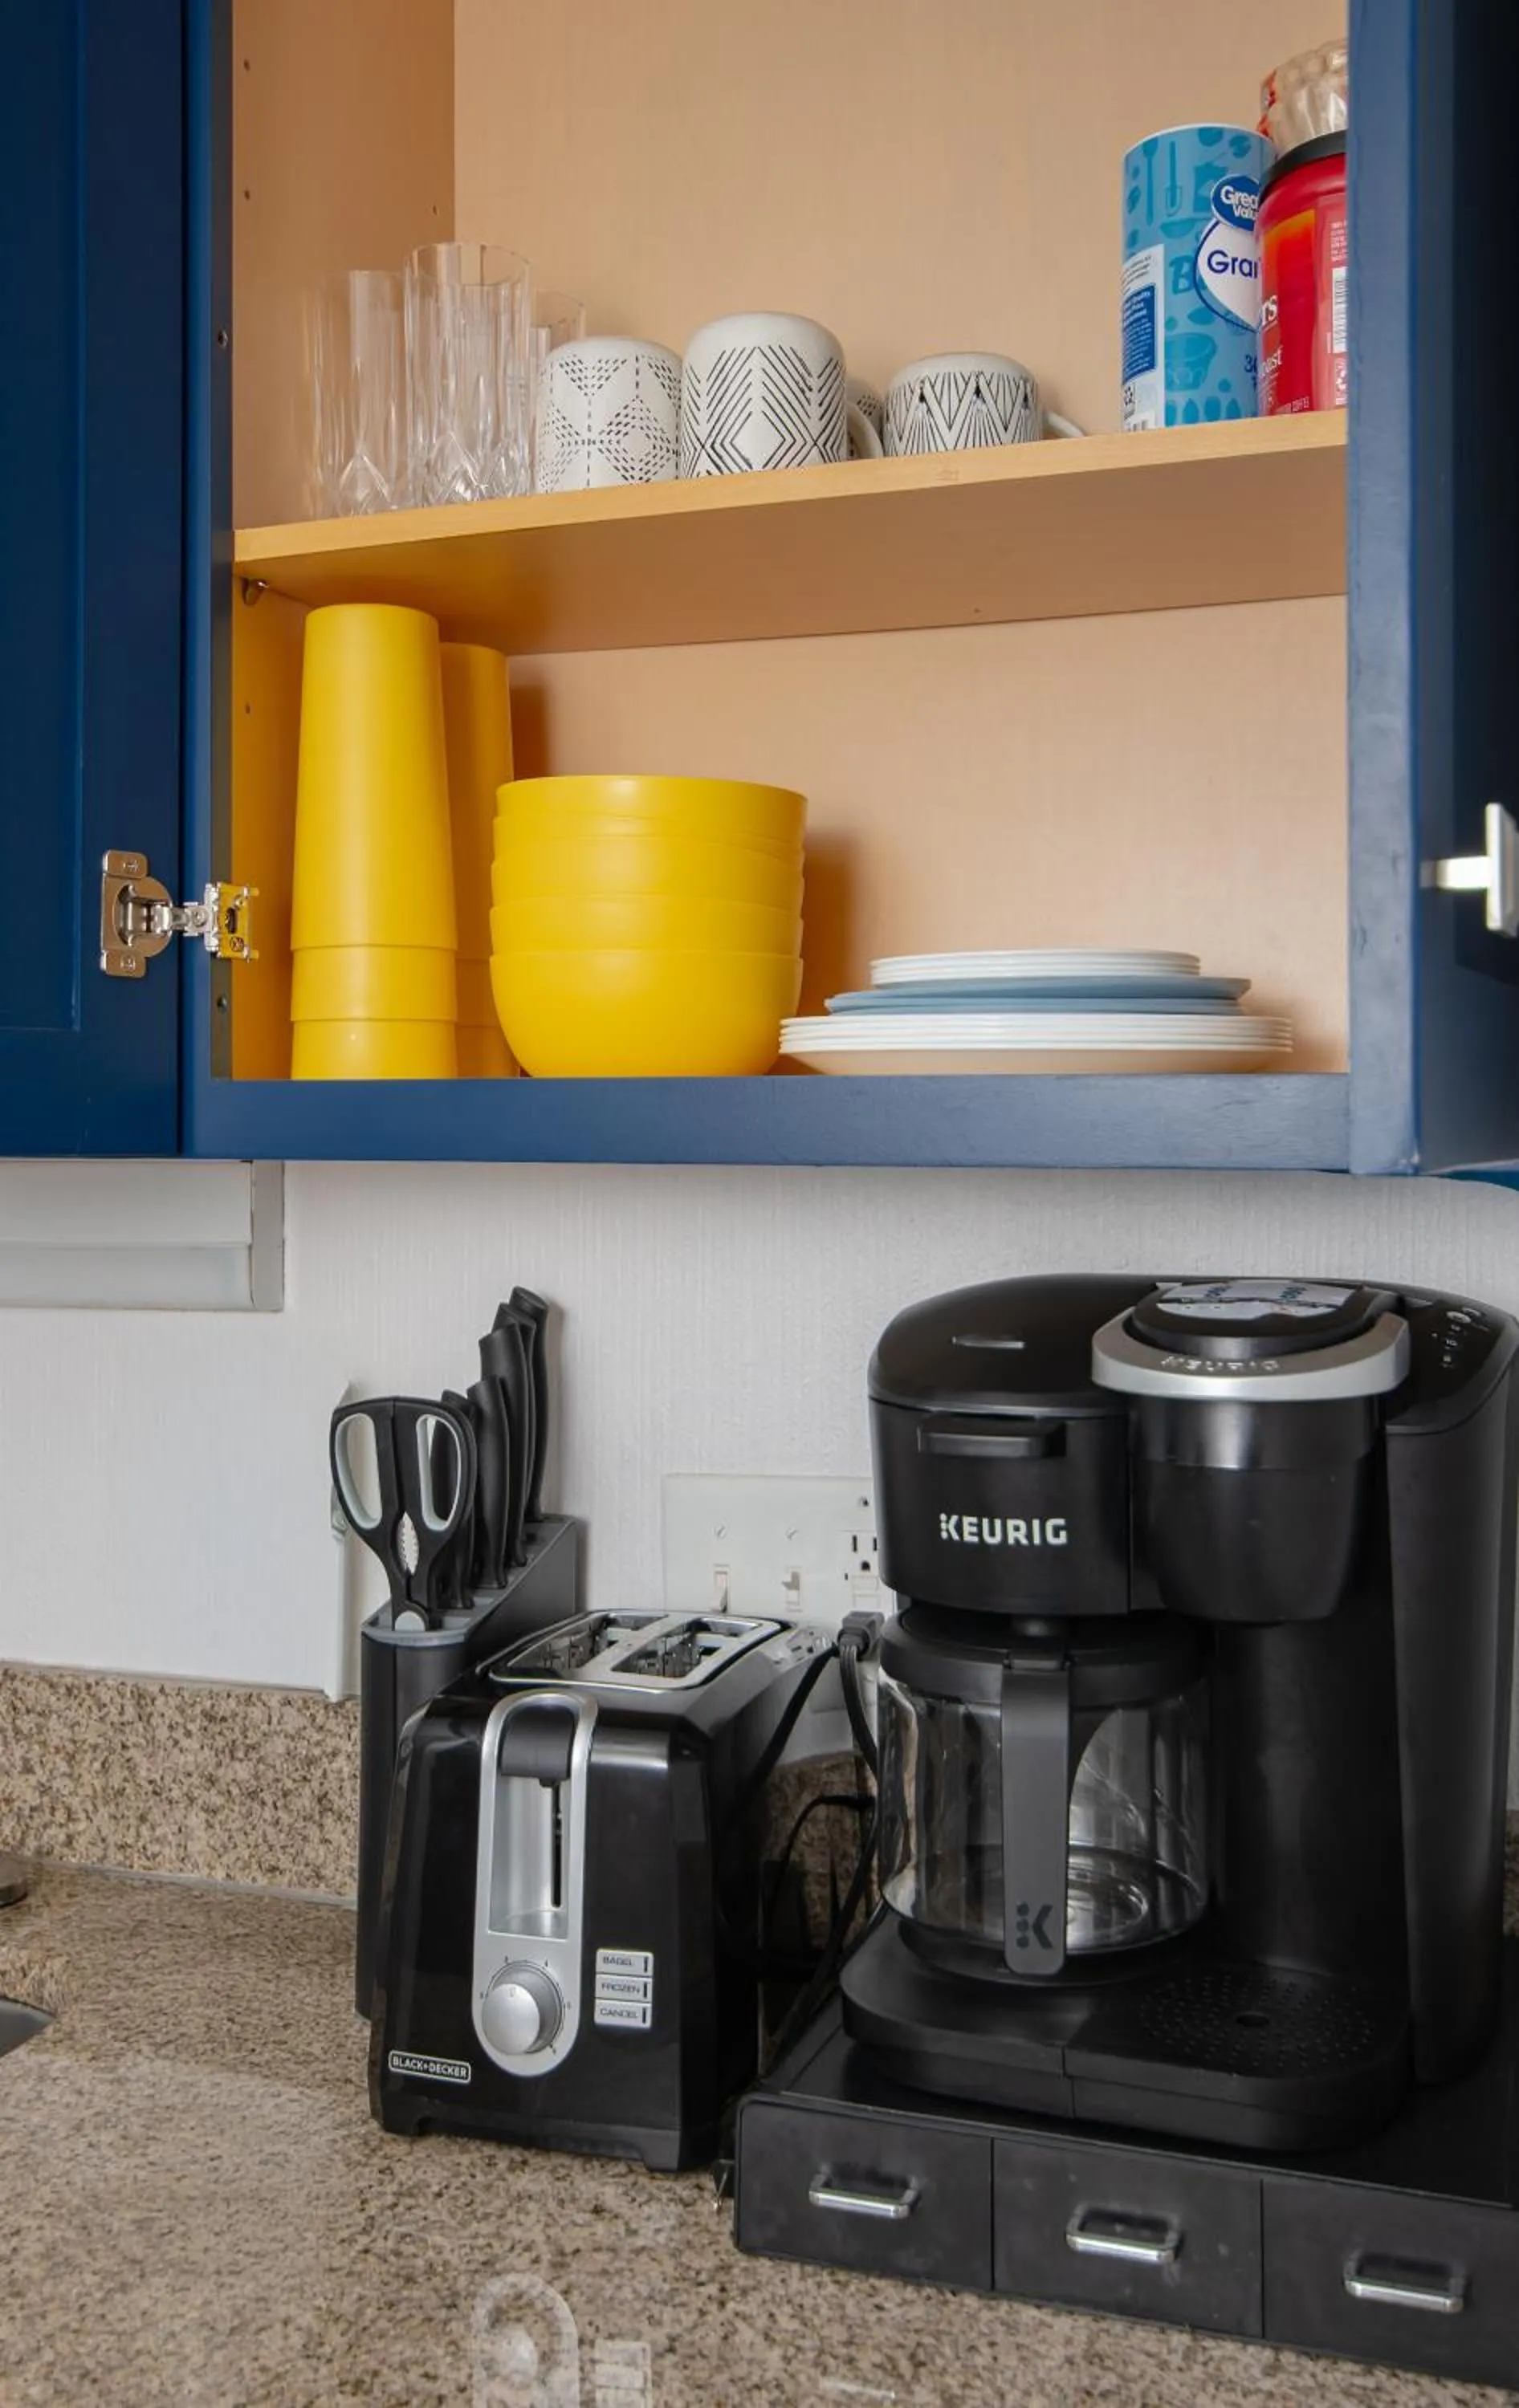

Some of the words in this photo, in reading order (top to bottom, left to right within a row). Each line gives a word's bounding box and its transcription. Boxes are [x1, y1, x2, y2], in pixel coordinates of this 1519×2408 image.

[1220, 185, 1259, 207] Grea
[1232, 204, 1259, 220] Valu
[939, 1512, 1068, 1546] KEURIG
[603, 1955, 634, 1967] BAGEL
[601, 1983, 641, 1994] FROZEN
[600, 2007, 638, 2019] CANCEL
